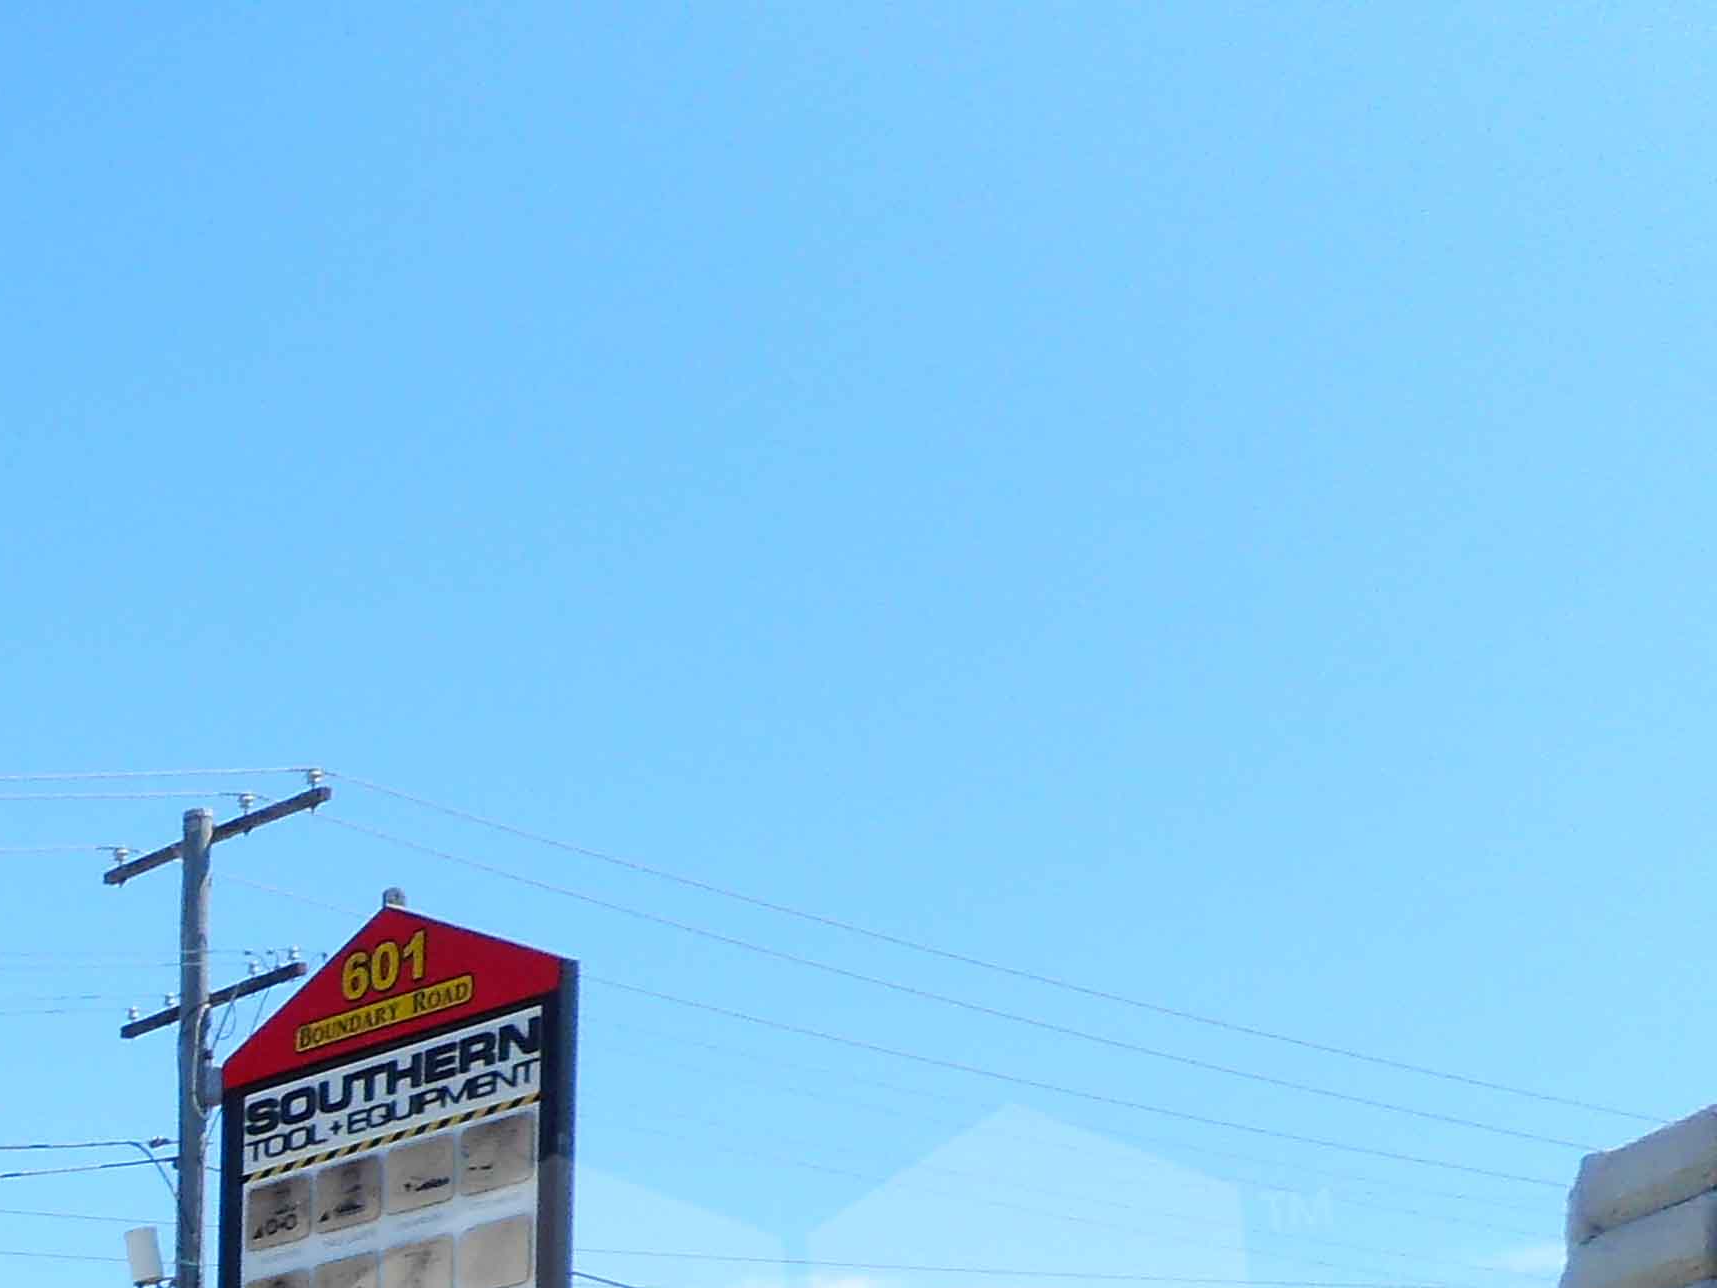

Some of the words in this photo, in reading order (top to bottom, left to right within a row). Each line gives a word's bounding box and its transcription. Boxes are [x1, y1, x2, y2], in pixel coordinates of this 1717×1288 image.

[342, 930, 427, 1001] 601
[298, 1004, 398, 1047] BOUNDARY
[412, 982, 469, 1014] ROAD
[246, 1016, 540, 1137] SOUTHERN
